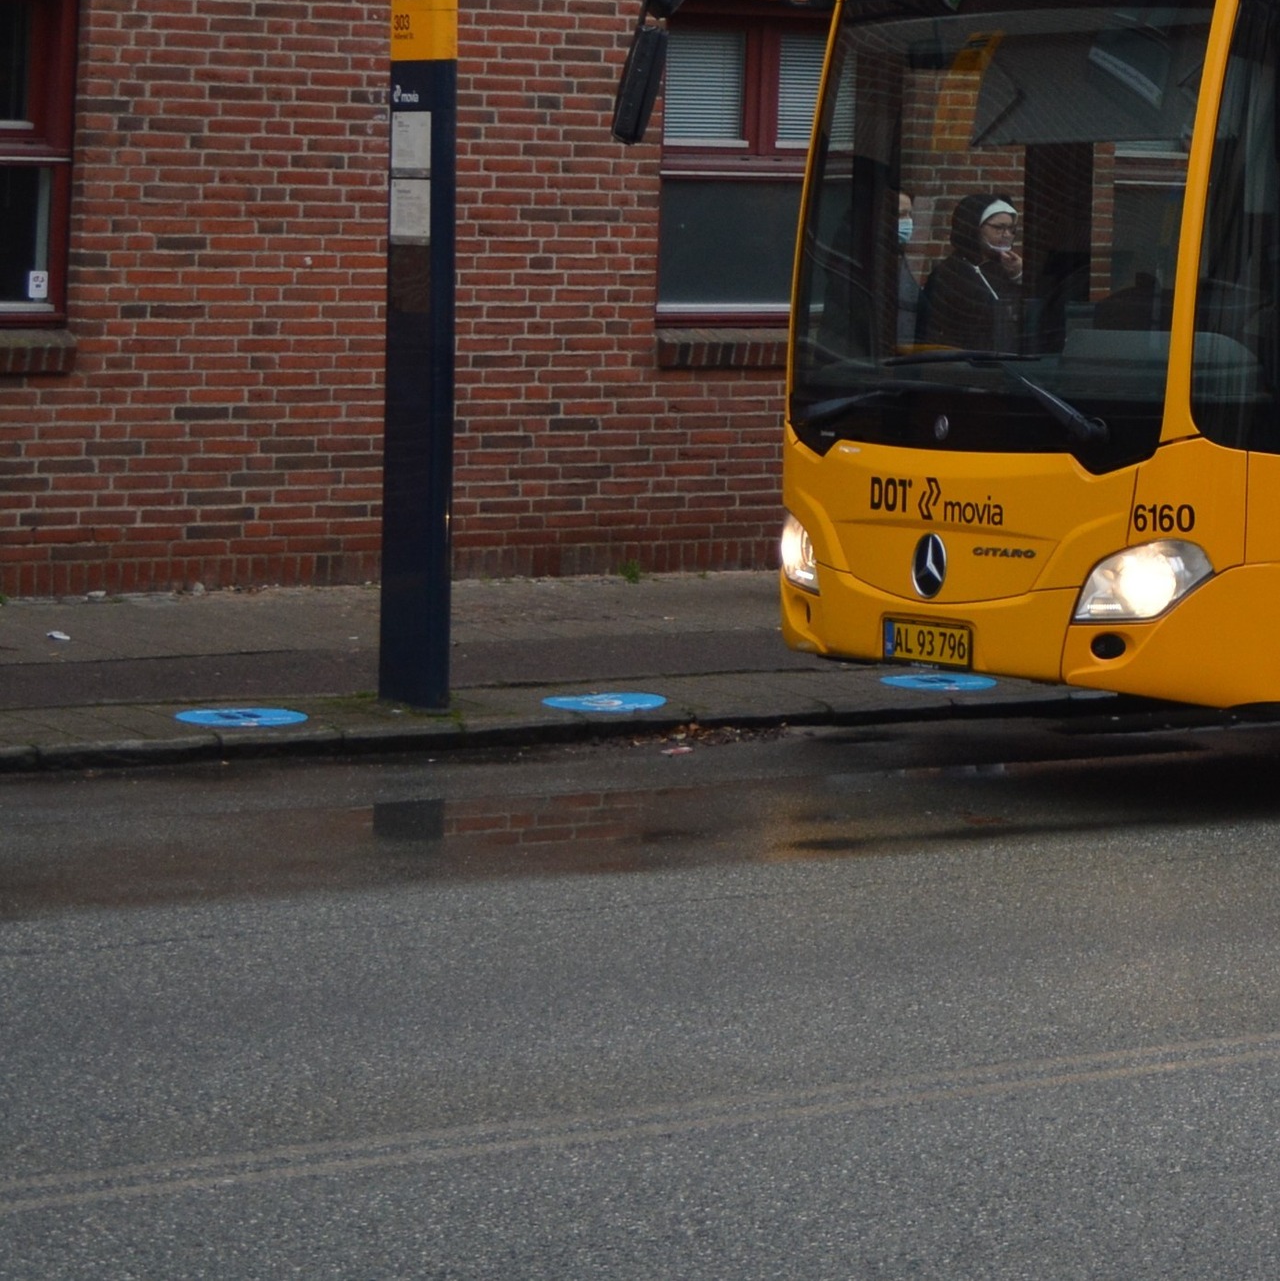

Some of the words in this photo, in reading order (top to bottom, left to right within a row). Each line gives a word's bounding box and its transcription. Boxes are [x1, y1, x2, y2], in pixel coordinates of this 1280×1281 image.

[394, 13, 410, 31] 303
[943, 495, 1003, 526] movia
[1134, 504, 1195, 533] 6160
[972, 546, 1036, 559] CITARO
[894, 627, 914, 654] AL
[917, 629, 935, 657] 93
[938, 631, 967, 660] 796
